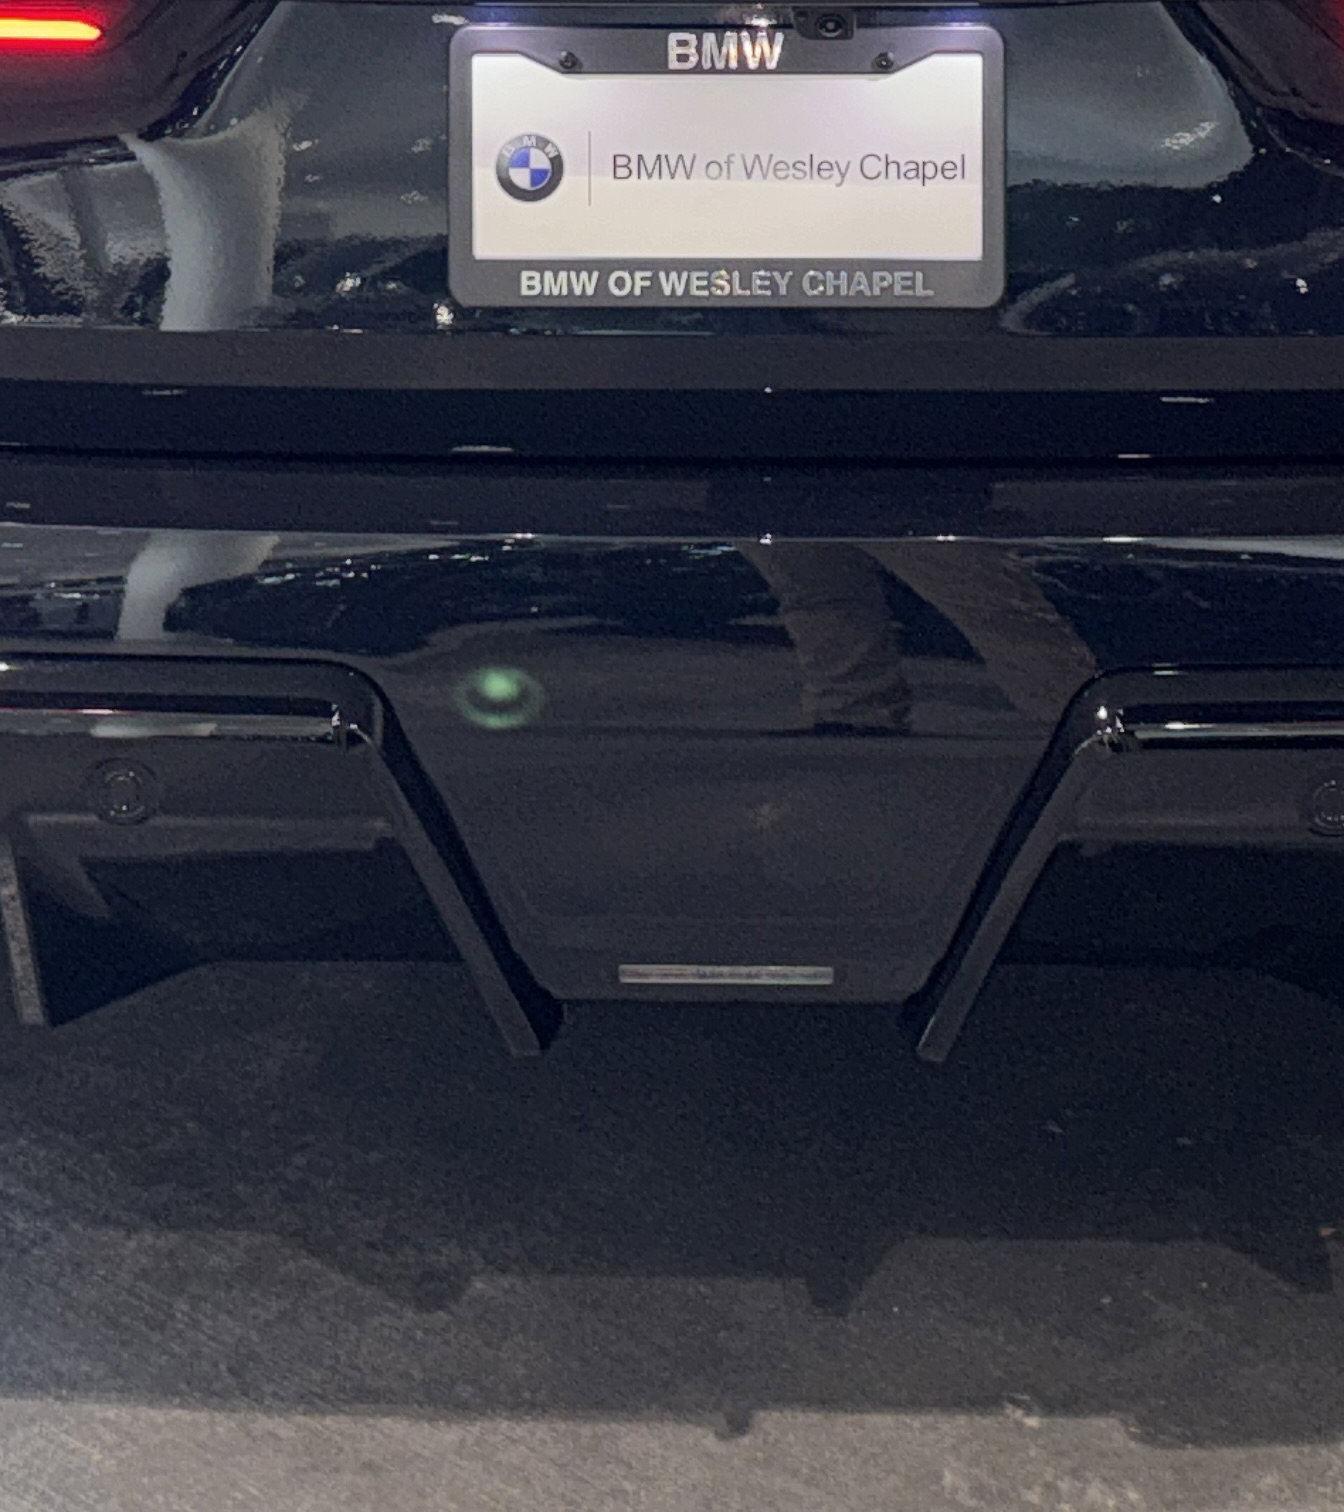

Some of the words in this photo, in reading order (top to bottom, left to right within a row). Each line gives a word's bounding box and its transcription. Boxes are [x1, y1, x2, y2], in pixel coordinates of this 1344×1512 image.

[667, 30, 784, 70] BMW
[612, 153, 697, 181] BMW
[705, 153, 736, 181] of
[740, 153, 851, 188] Wesley
[859, 153, 966, 187] Chapel
[520, 270, 600, 296] BMW
[608, 270, 653, 297] OF
[658, 269, 793, 297] WESLEY
[802, 270, 936, 297] CHAPEL
